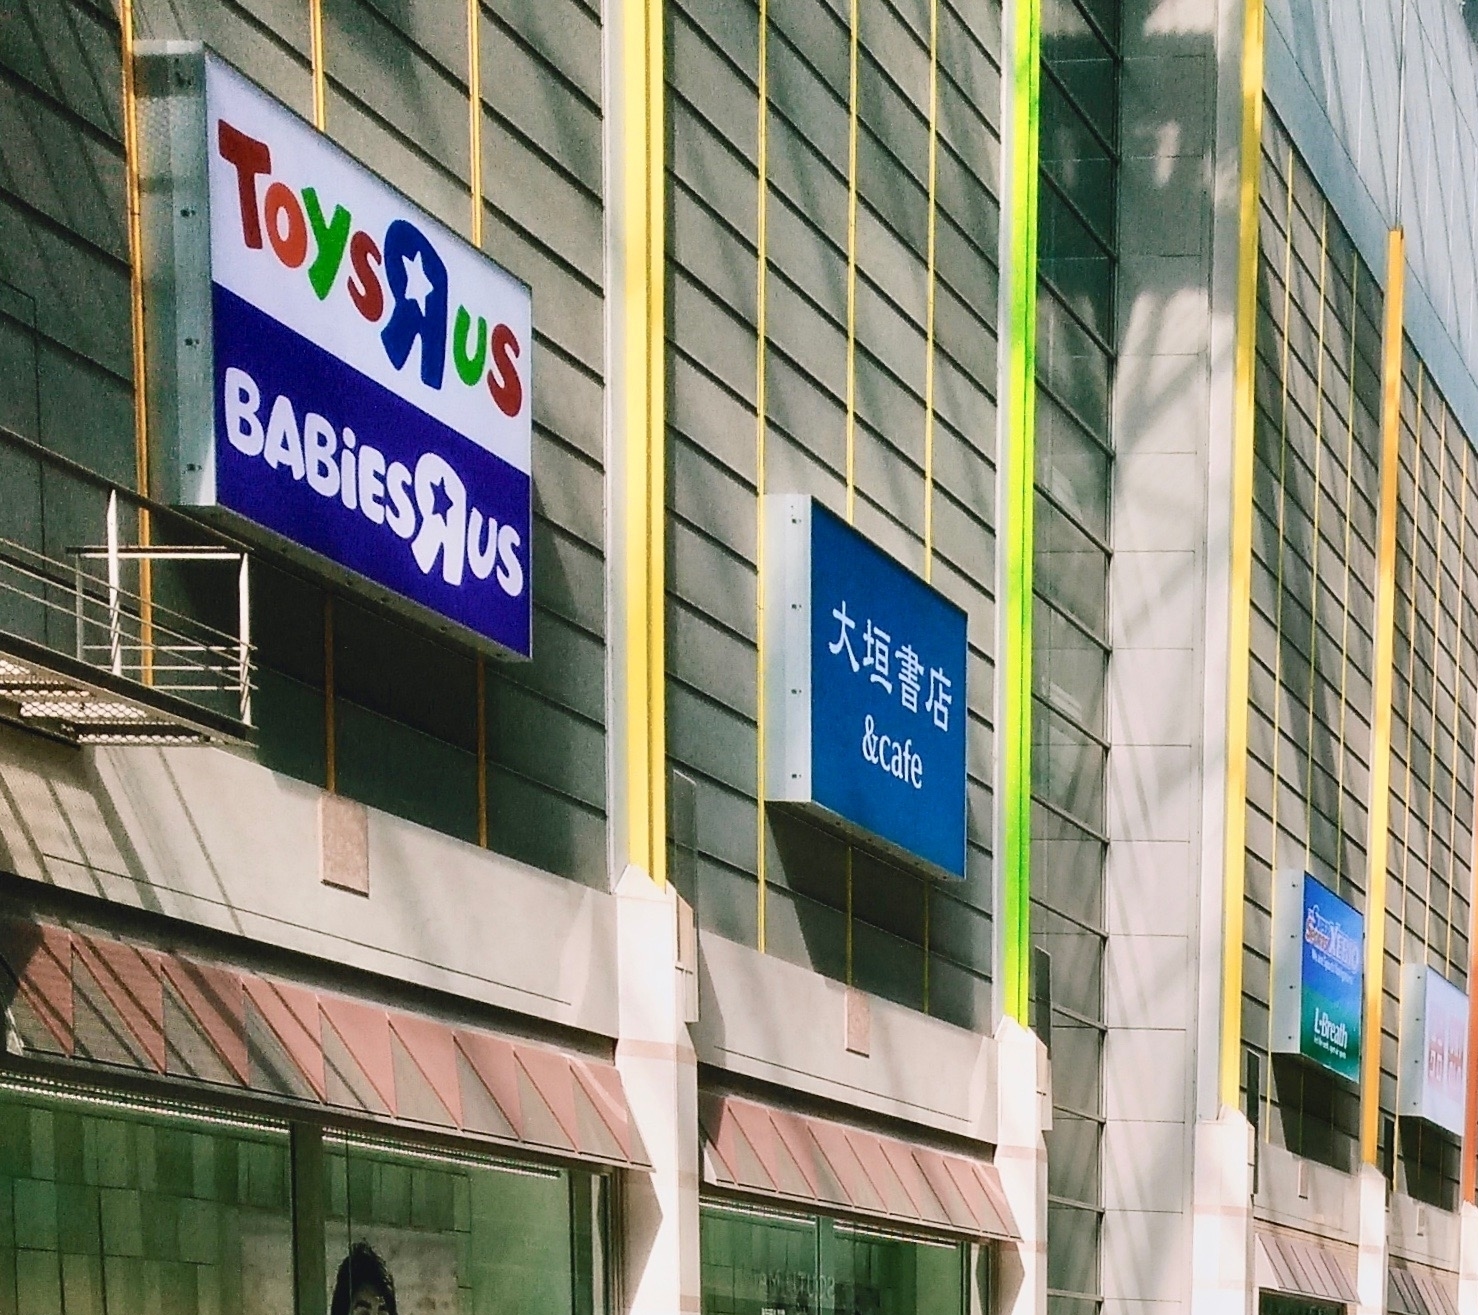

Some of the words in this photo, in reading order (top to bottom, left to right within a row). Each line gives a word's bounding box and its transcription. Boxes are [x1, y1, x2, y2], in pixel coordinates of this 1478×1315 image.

[828, 599, 953, 733] 大垣書店
[862, 714, 924, 790] &cafe
